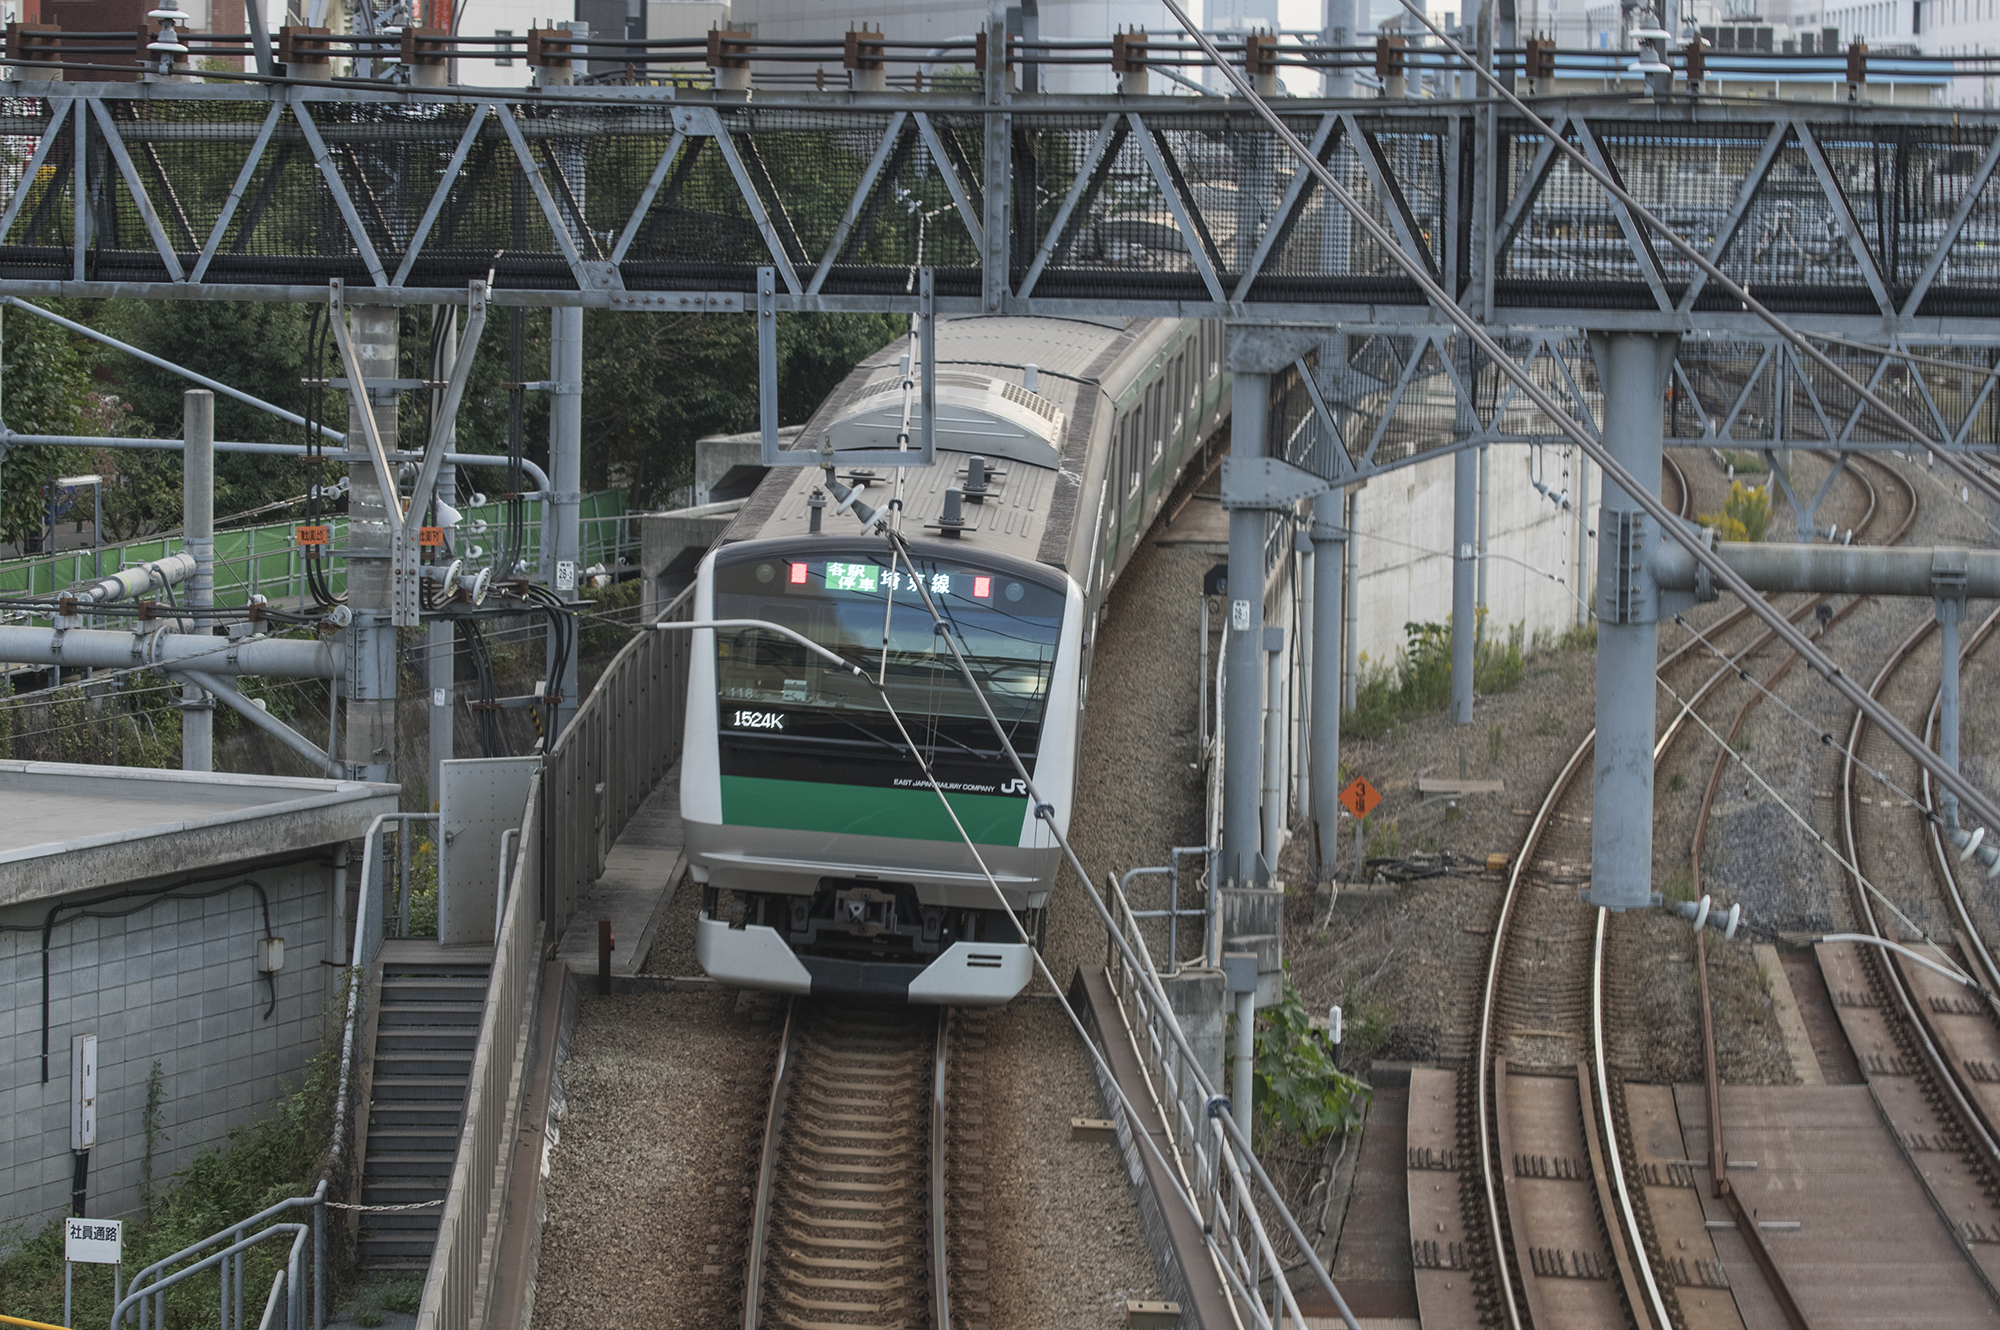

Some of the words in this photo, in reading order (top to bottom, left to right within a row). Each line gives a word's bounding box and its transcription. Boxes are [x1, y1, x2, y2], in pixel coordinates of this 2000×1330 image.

[559, 568, 573, 579] 28-2
[828, 562, 866, 578] 各駅
[838, 576, 876, 591] 停車
[733, 710, 785, 729] 1524K
[893, 778, 913, 786] EAST
[962, 783, 996, 793] COMPANY
[1000, 778, 1027, 795] JR
[1355, 782, 1366, 797] 3
[70, 1224, 117, 1242] 社員通路
